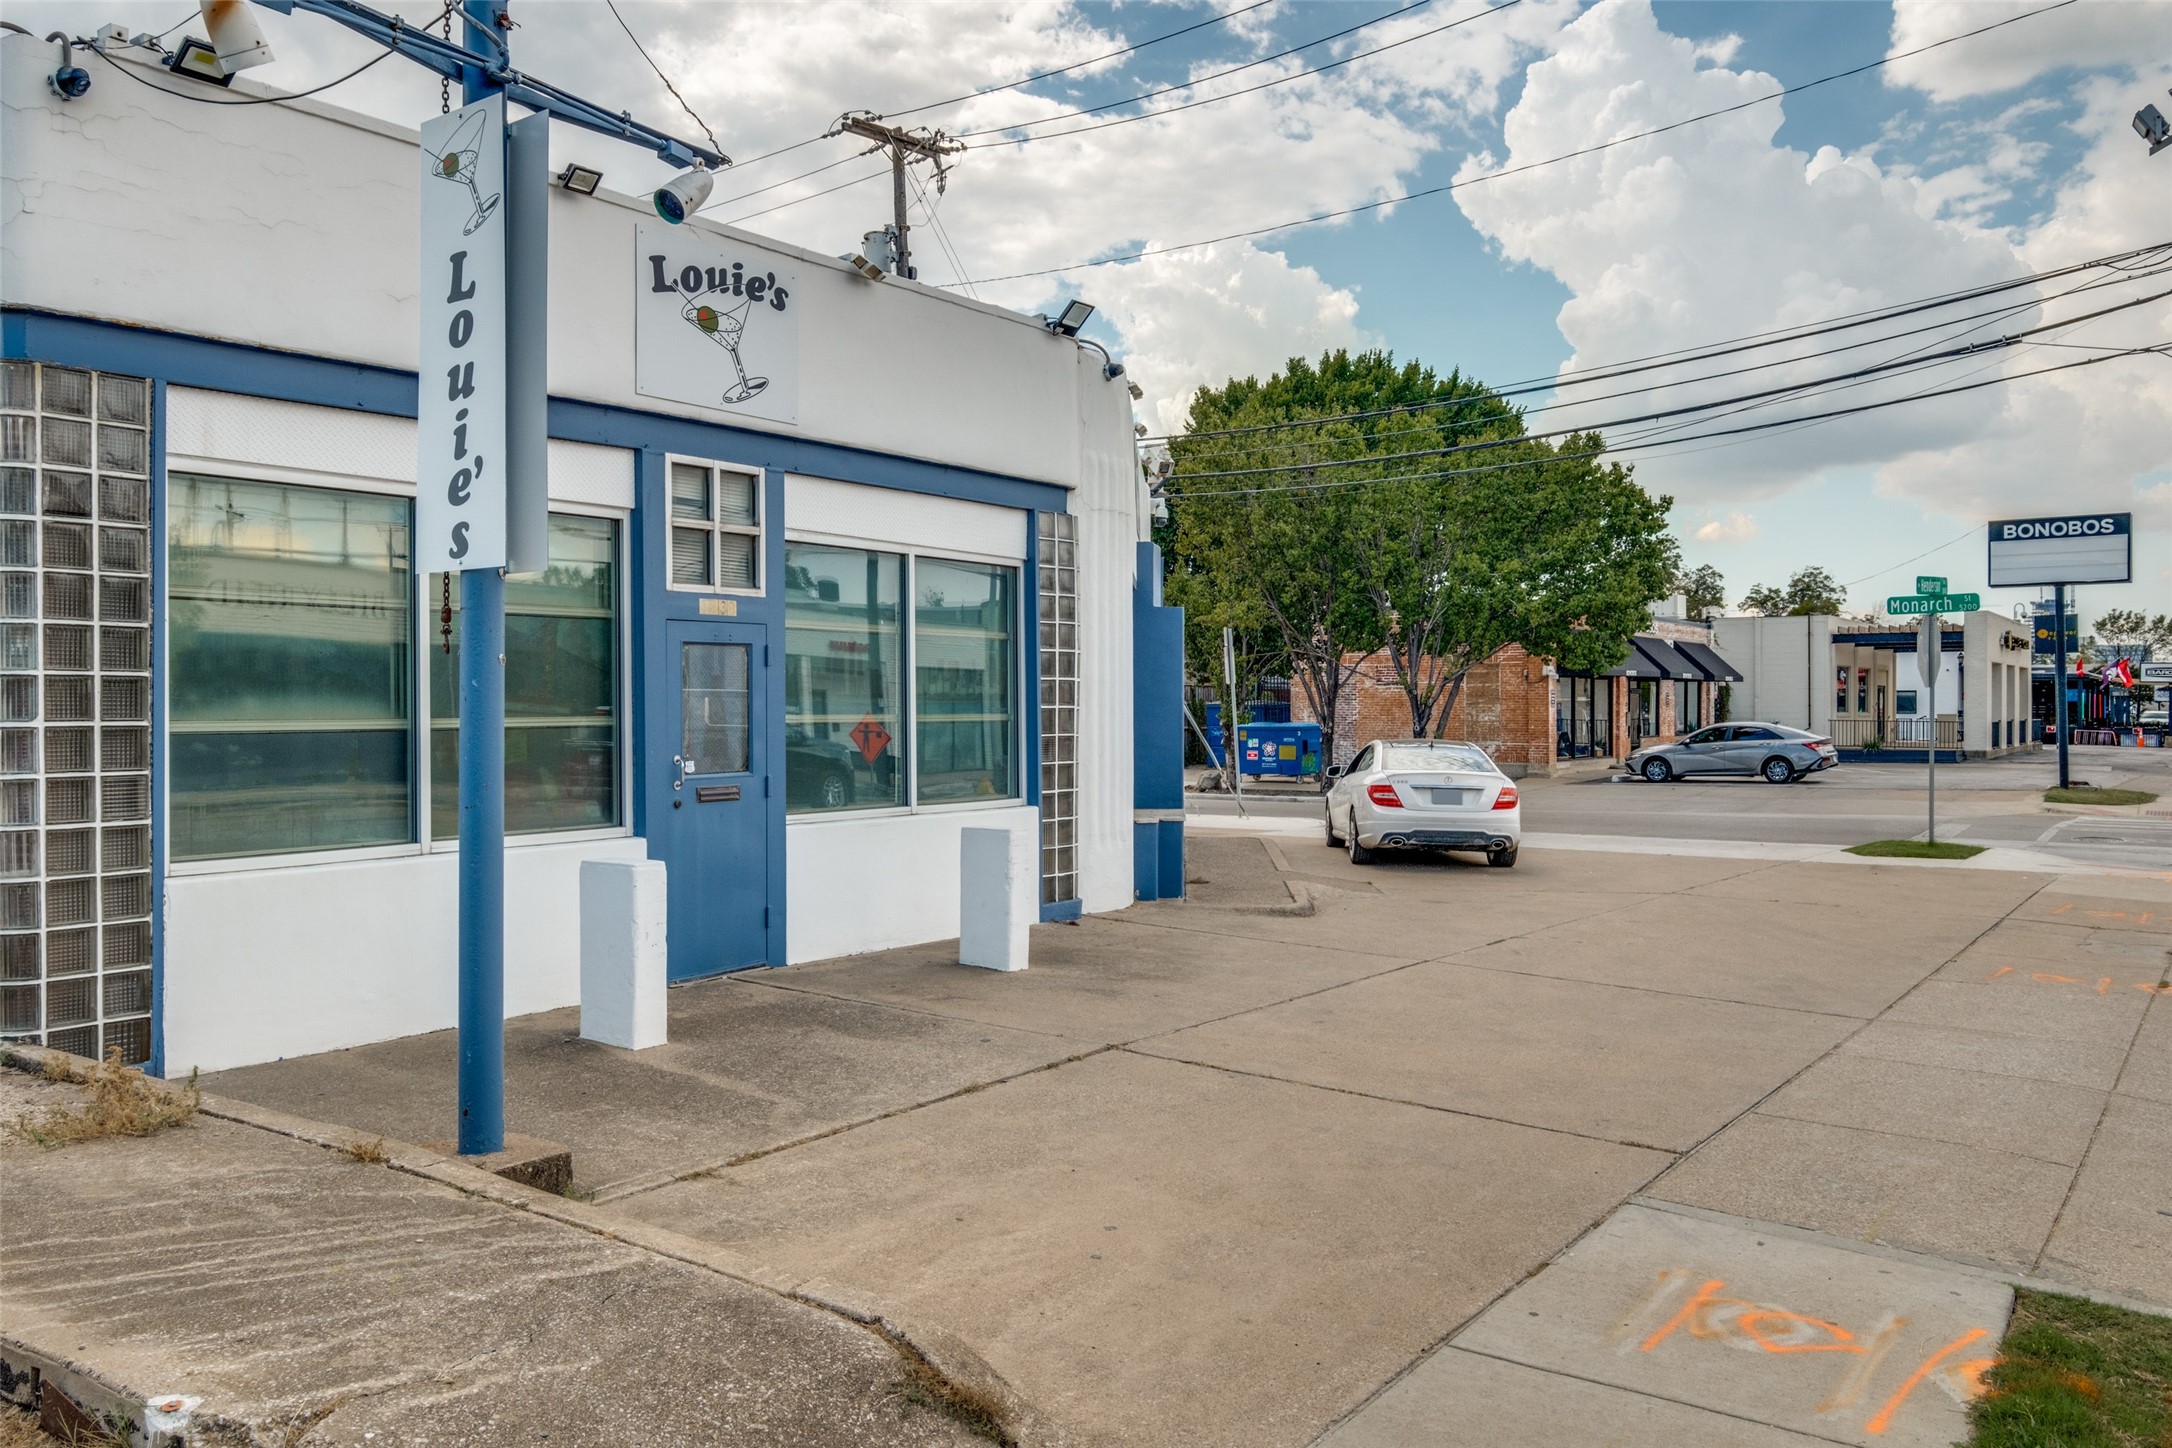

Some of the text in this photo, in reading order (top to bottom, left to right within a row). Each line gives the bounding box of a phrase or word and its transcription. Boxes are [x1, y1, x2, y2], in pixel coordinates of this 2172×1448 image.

[648, 254, 789, 312] Louie's
[447, 250, 484, 560] Louie's
[2003, 518, 2115, 539] BONOBOS
[1890, 596, 1952, 613] Monarch
[1959, 603, 1978, 611] 5200
